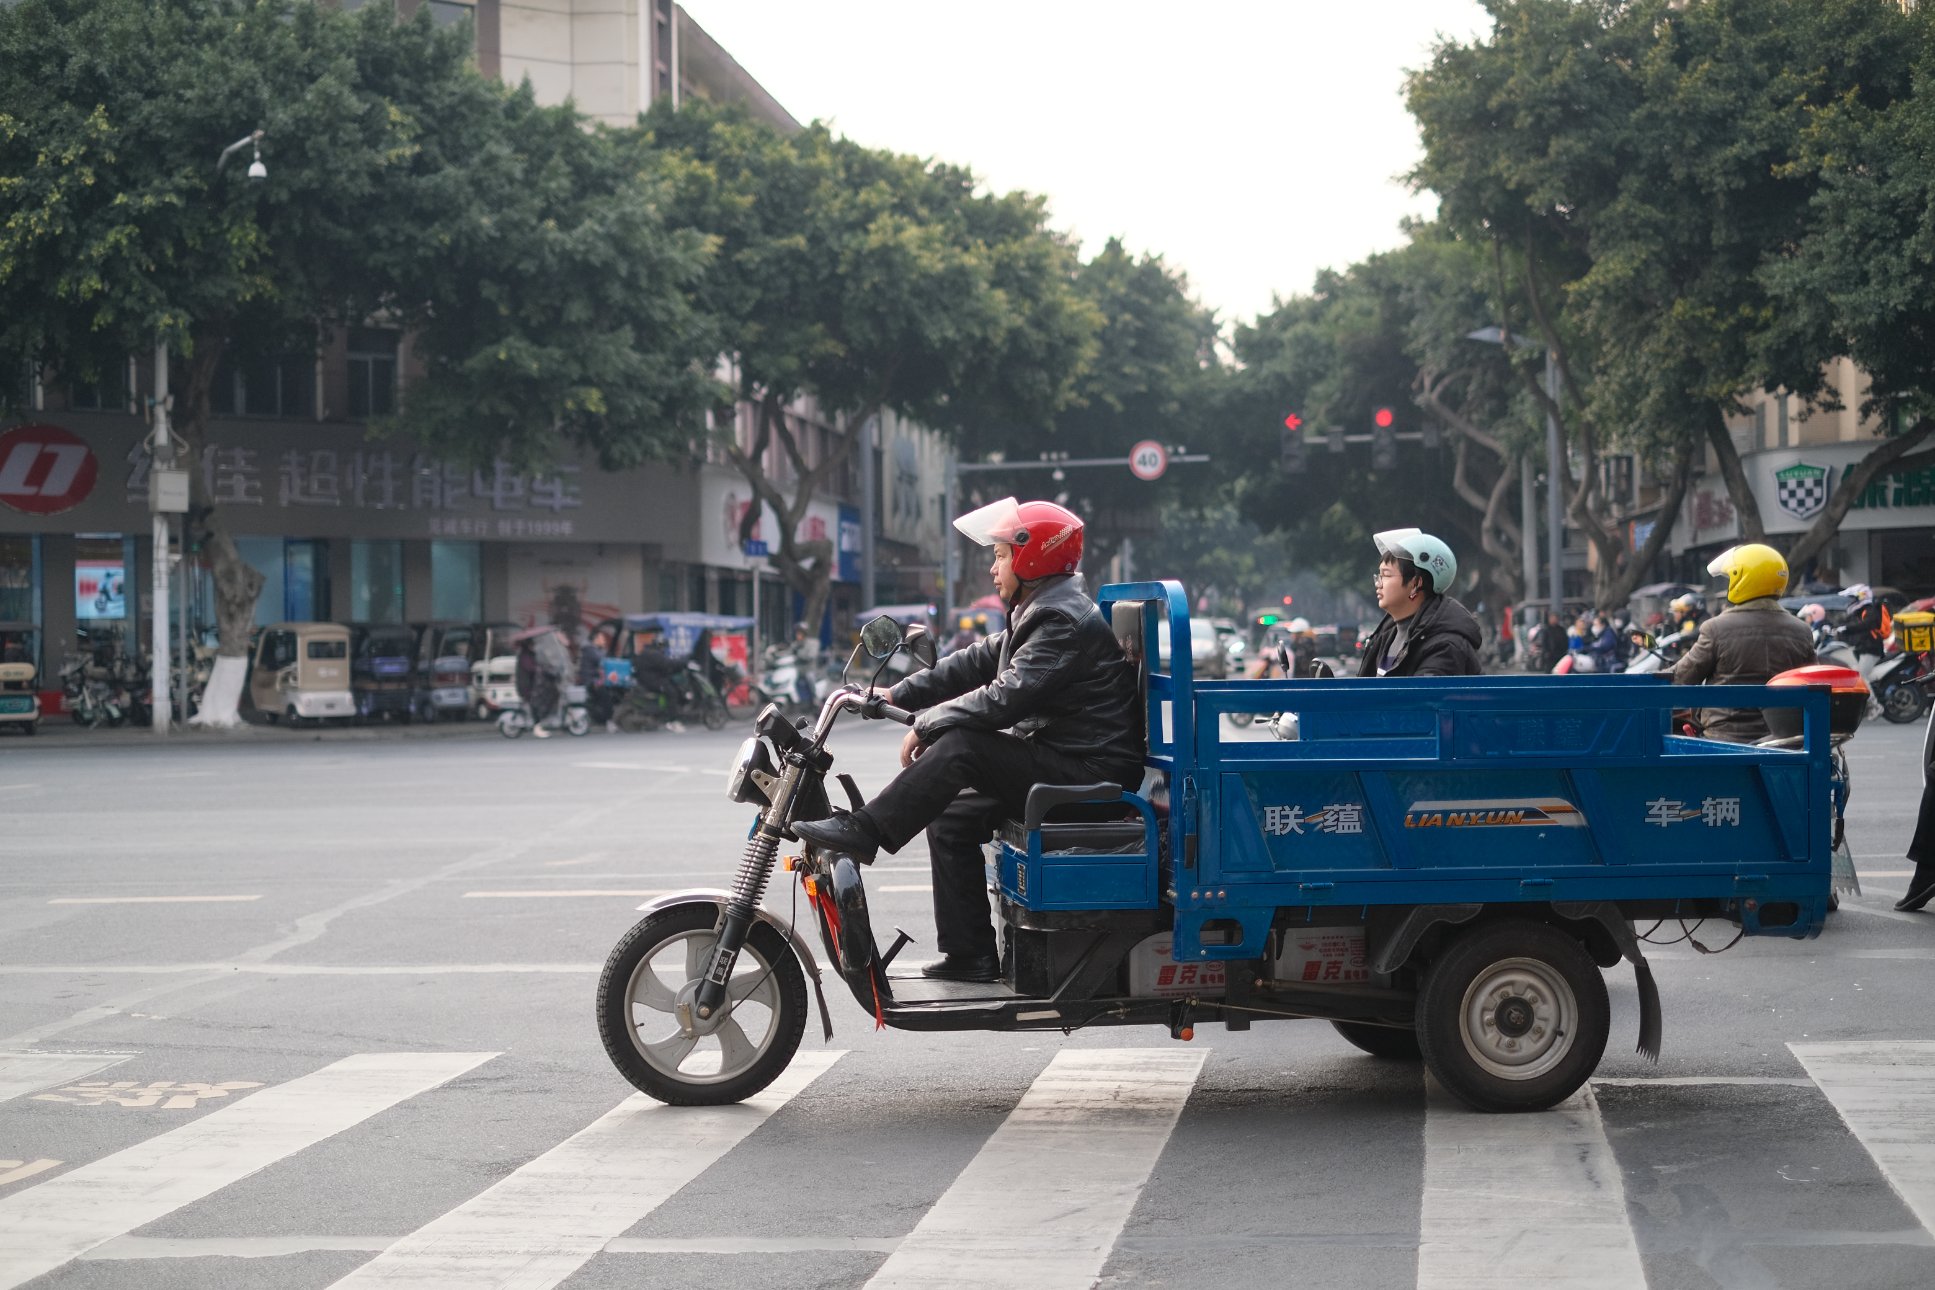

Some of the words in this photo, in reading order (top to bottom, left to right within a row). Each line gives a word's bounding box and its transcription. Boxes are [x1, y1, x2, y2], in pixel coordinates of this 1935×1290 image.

[1137, 452, 1159, 468] 40
[1263, 803, 1363, 836] 联蕴
[1403, 810, 1525, 828] LIANYUN
[1644, 796, 1741, 828] 车辆
[1157, 964, 1199, 986] 雷克
[1301, 960, 1344, 981] 雷克
